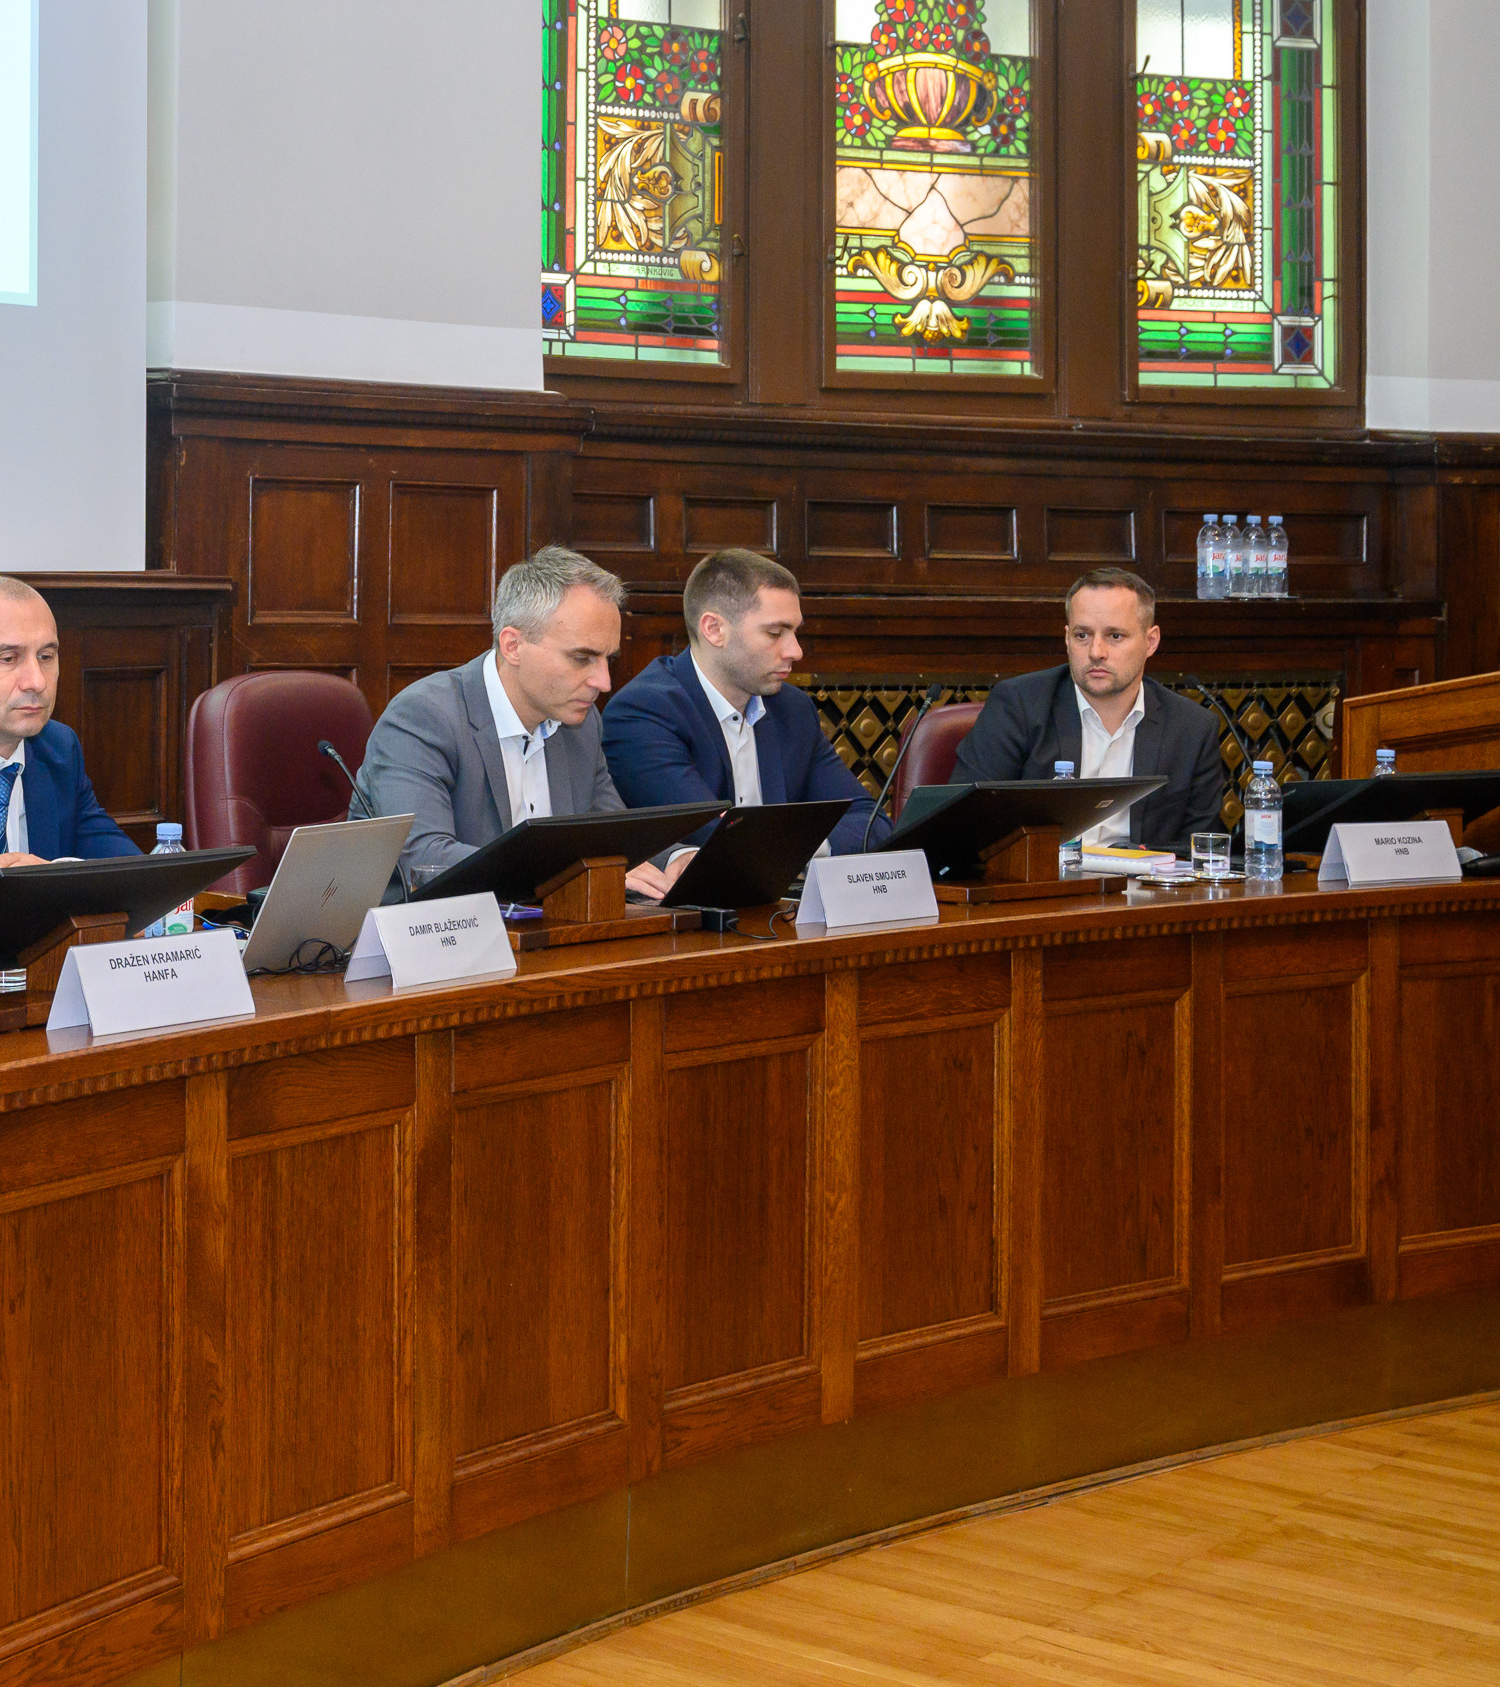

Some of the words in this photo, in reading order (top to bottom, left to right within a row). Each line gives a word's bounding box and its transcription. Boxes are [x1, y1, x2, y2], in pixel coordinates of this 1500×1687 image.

[1374, 837, 1397, 845] MARIO
[1397, 836, 1423, 845] KOZINA
[847, 873, 874, 884] SLAVEN
[875, 870, 907, 881] SMOJVER
[872, 884, 888, 894] HNB
[408, 924, 434, 936] DAMIR
[434, 915, 478, 932] BLAŽEKOVIĆ
[440, 936, 457, 947] HNB
[109, 953, 150, 970] DRAŽEN
[150, 945, 202, 964] KRAMARIĆ
[144, 968, 178, 982] HANFA
